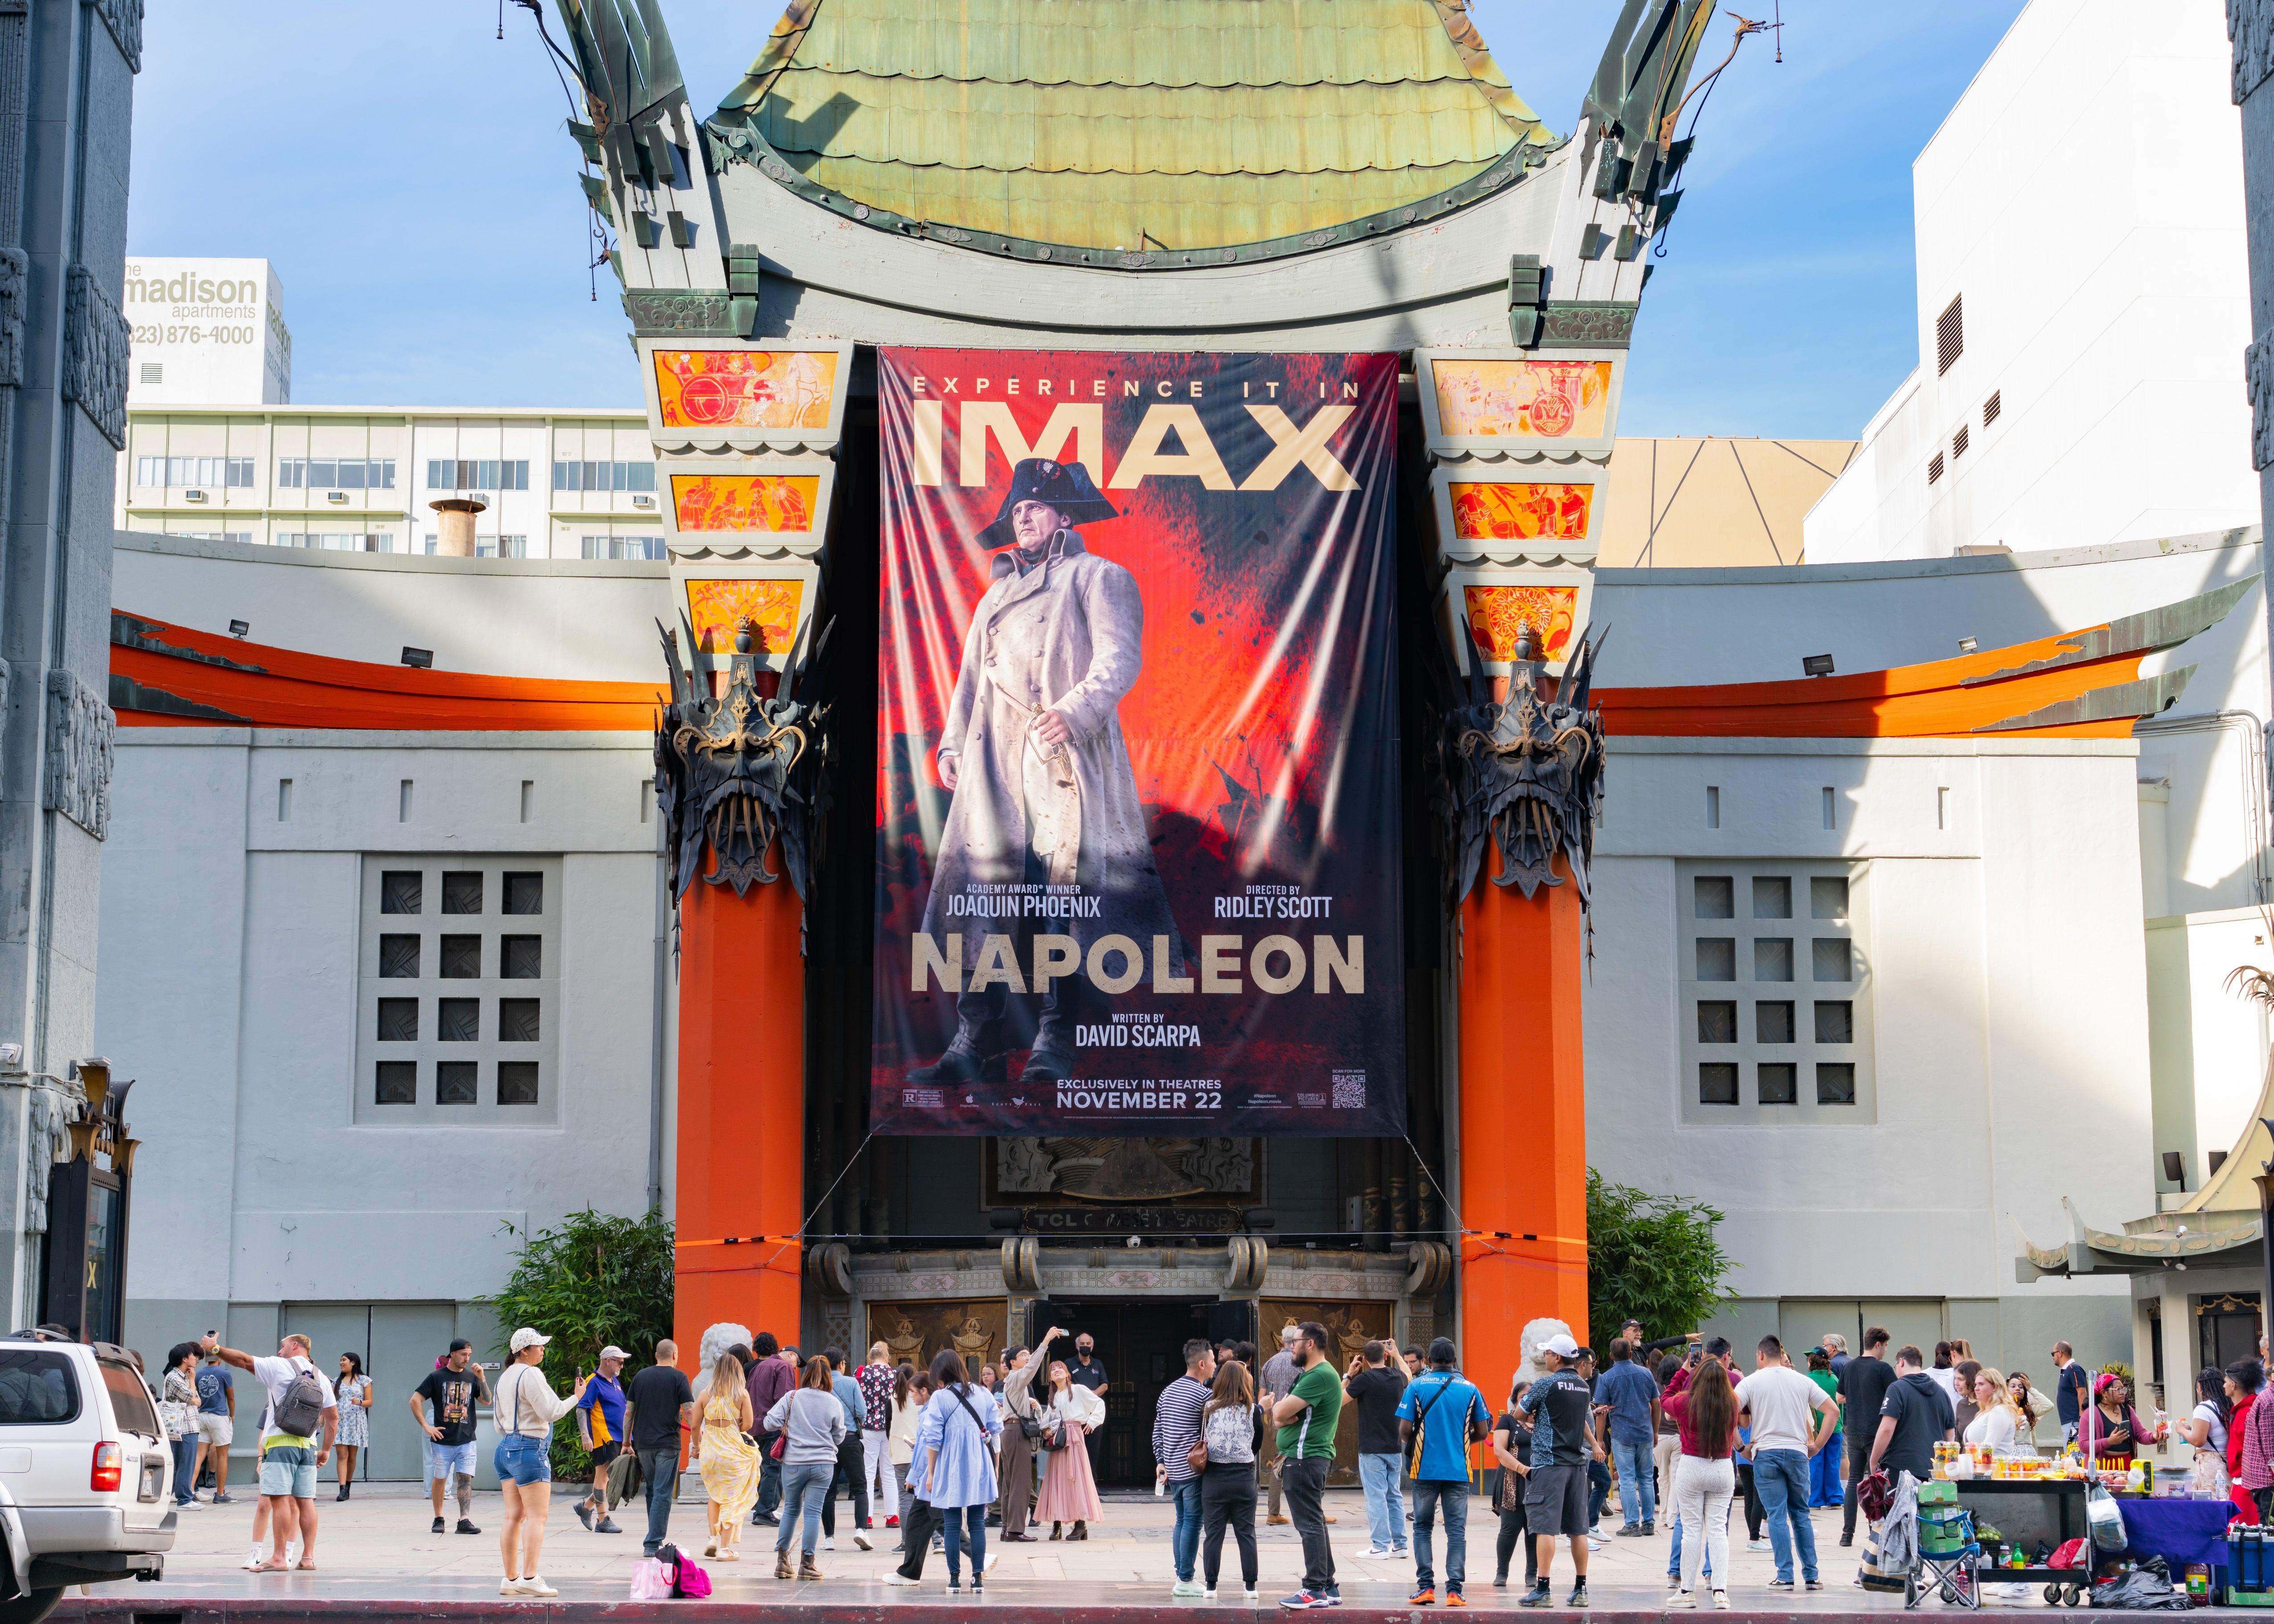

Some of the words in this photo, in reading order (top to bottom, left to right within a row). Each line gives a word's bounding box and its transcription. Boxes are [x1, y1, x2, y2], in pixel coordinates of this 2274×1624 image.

[124, 272, 257, 304] madison
[172, 304, 255, 321] apartments
[167, 325, 254, 345] 876-4000
[267, 299, 291, 359] madison
[914, 376, 1203, 398] EXPERIENCE
[1244, 381, 1280, 399] IT
[1320, 381, 1359, 399] IN
[913, 399, 1362, 491] IMAX
[966, 884, 1006, 893] ACADEMY
[1046, 885, 1080, 894] WINNER
[1246, 885, 1286, 895] DIRECTED
[1289, 886, 1300, 895] BY
[946, 895, 1019, 918] JOAQUIN
[1024, 896, 1101, 917] PHOENIX
[1215, 896, 1275, 918] RIDLEY
[1277, 896, 1332, 918] SCOTT
[911, 932, 1365, 995] NAPOLEON
[1112, 1014, 1150, 1023] WRITTEN
[1153, 1014, 1164, 1023] BY
[1076, 1025, 1128, 1047] DAVID
[1132, 1025, 1201, 1047] SCARPA
[1057, 1079, 1138, 1089] EXCLUSIVELY
[1142, 1079, 1154, 1089] IN
[1159, 1079, 1222, 1089] THEATRES
[904, 1094, 915, 1102] R
[1057, 1092, 1186, 1109] NOVEMBER
[1195, 1092, 1222, 1109] 22
[1034, 1214, 1077, 1227] TCL
[1557, 1381, 1574, 1391] FIJI
